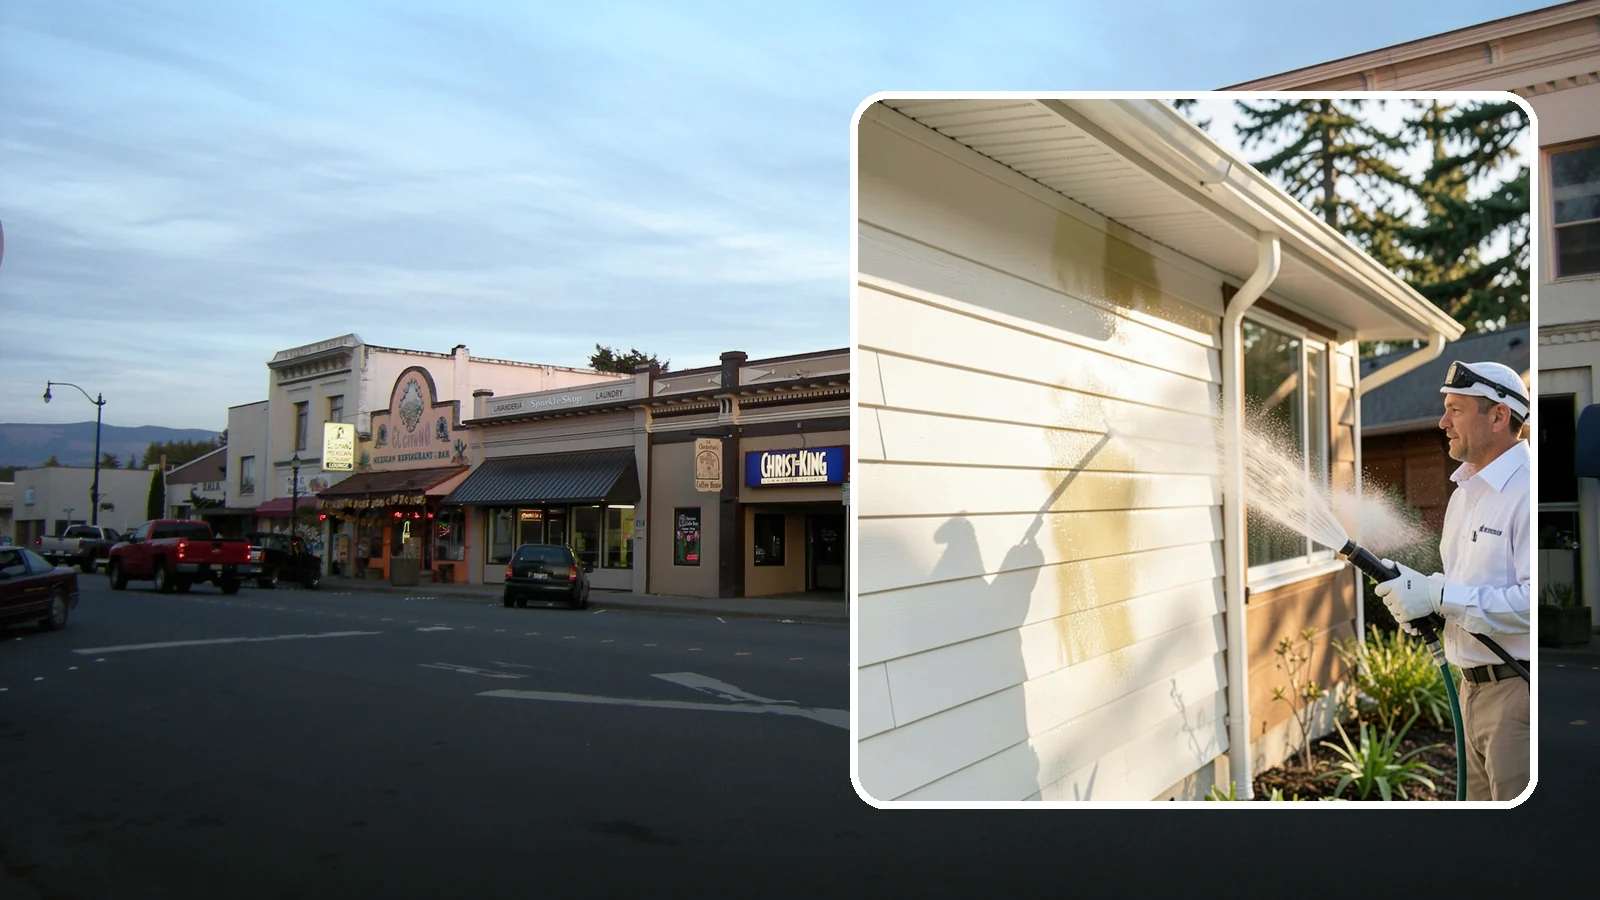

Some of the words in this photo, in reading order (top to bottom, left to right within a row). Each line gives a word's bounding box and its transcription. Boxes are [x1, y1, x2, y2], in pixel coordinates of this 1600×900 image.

[531, 398, 560, 409] Sparkle
[561, 394, 583, 407] Shop
[595, 389, 624, 400] LAUNDRY
[493, 402, 523, 413] LAVANDERIA
[373, 454, 396, 464] MEXICAN
[398, 451, 434, 463] RESTAURANT
[437, 450, 450, 459] BAR
[760, 452, 797, 478] CHRIST
[799, 450, 828, 476] KING
